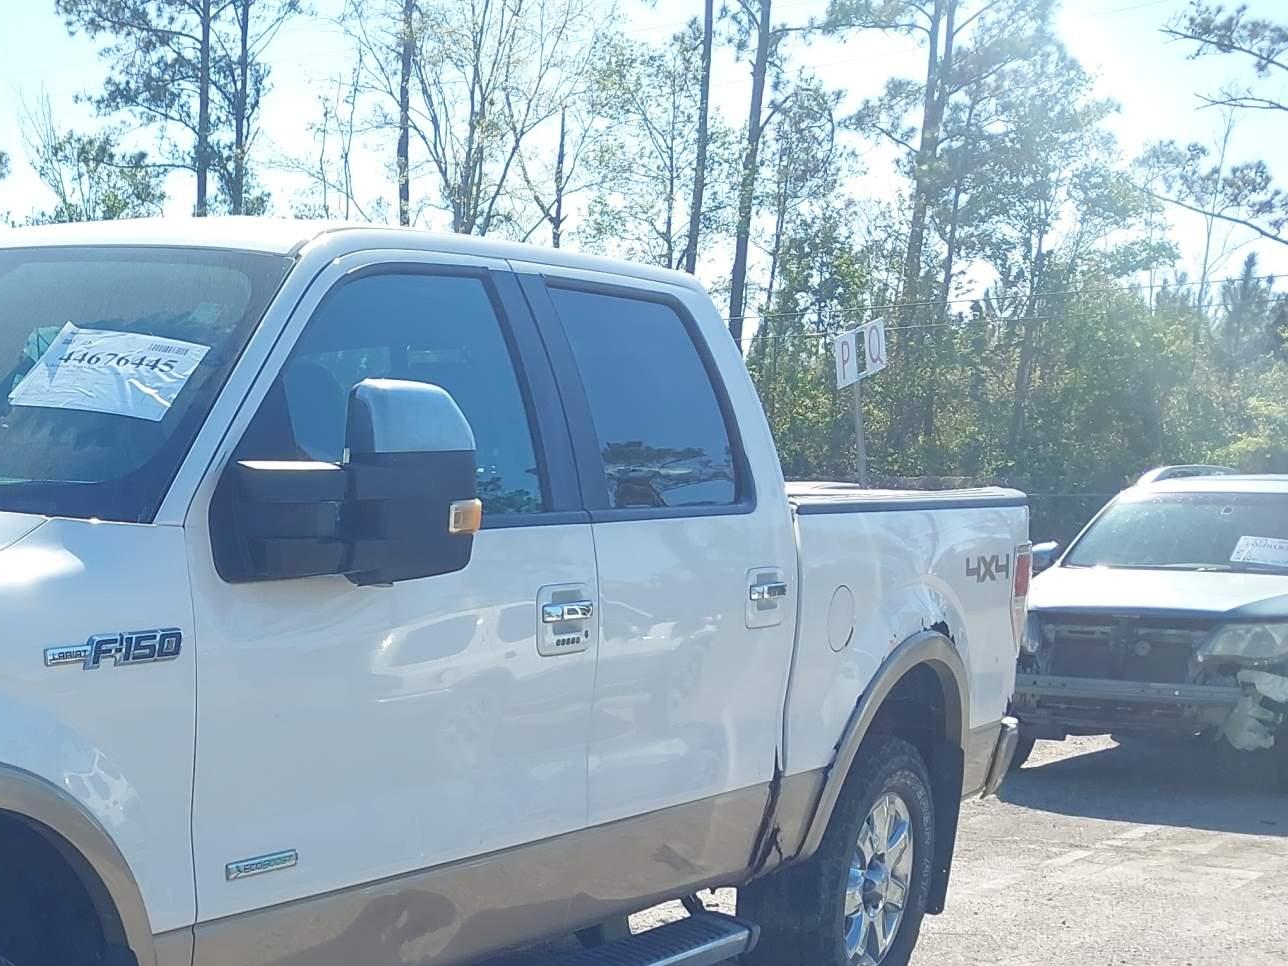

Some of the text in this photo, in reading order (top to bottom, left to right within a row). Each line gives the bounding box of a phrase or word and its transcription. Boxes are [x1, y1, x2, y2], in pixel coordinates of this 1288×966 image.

[58, 350, 179, 373] 44676445
[51, 630, 183, 667] LARIAT F-150
